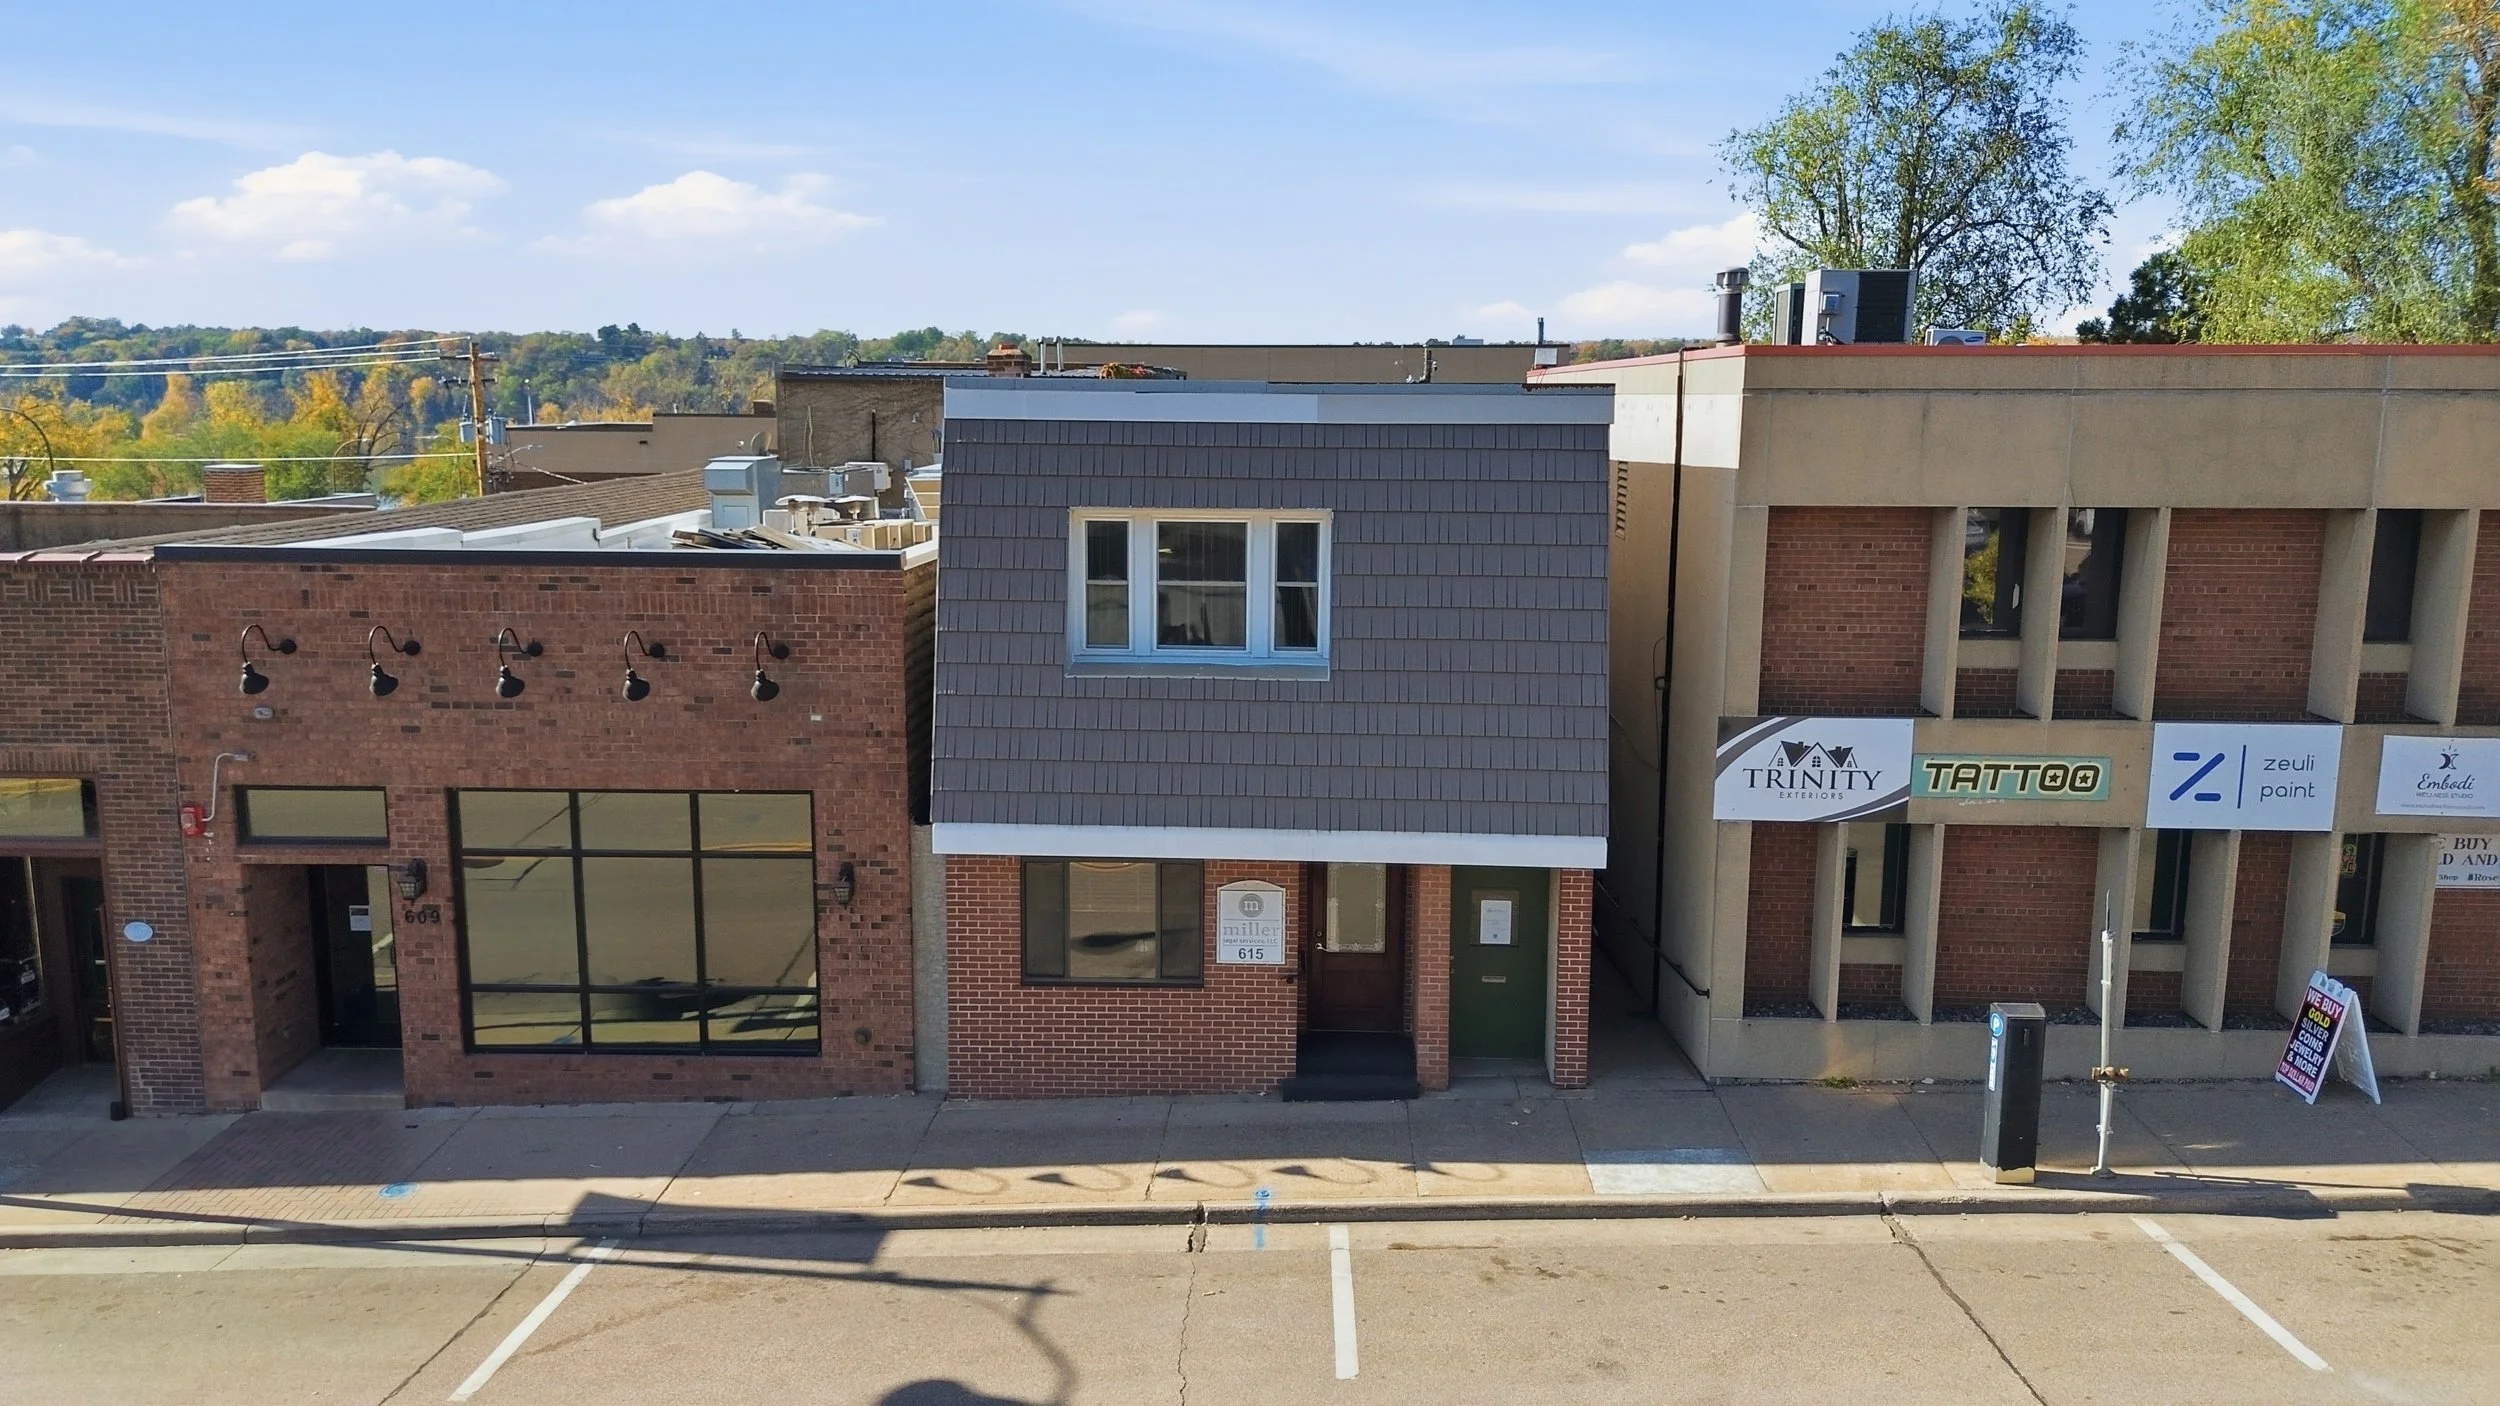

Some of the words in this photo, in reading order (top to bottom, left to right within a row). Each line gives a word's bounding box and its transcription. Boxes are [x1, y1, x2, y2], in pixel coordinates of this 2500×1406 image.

[2263, 753, 2315, 771] zeuli
[1742, 768, 1883, 790] TRINITY
[1925, 762, 2101, 793] TATTOO
[2417, 773, 2475, 790] Embodi
[1779, 791, 1844, 800] EXTERIORS
[2260, 781, 2316, 803] paint
[2453, 837, 2492, 850] BUY
[2461, 853, 2498, 866] AND
[1243, 900, 1260, 911] m
[405, 909, 441, 924] 609
[1223, 922, 1280, 937] miller
[1238, 947, 1264, 960] 615
[2307, 987, 2323, 1007] WE
[2321, 998, 2343, 1019] BUY
[2308, 1007, 2331, 1028] GOLD
[2301, 1017, 2329, 1042] SILVER
[2298, 1030, 2324, 1053] COINS
[2289, 1039, 2325, 1066] JEWELRY
[2286, 1050, 2295, 1062] &
[2294, 1055, 2319, 1079] MORE
